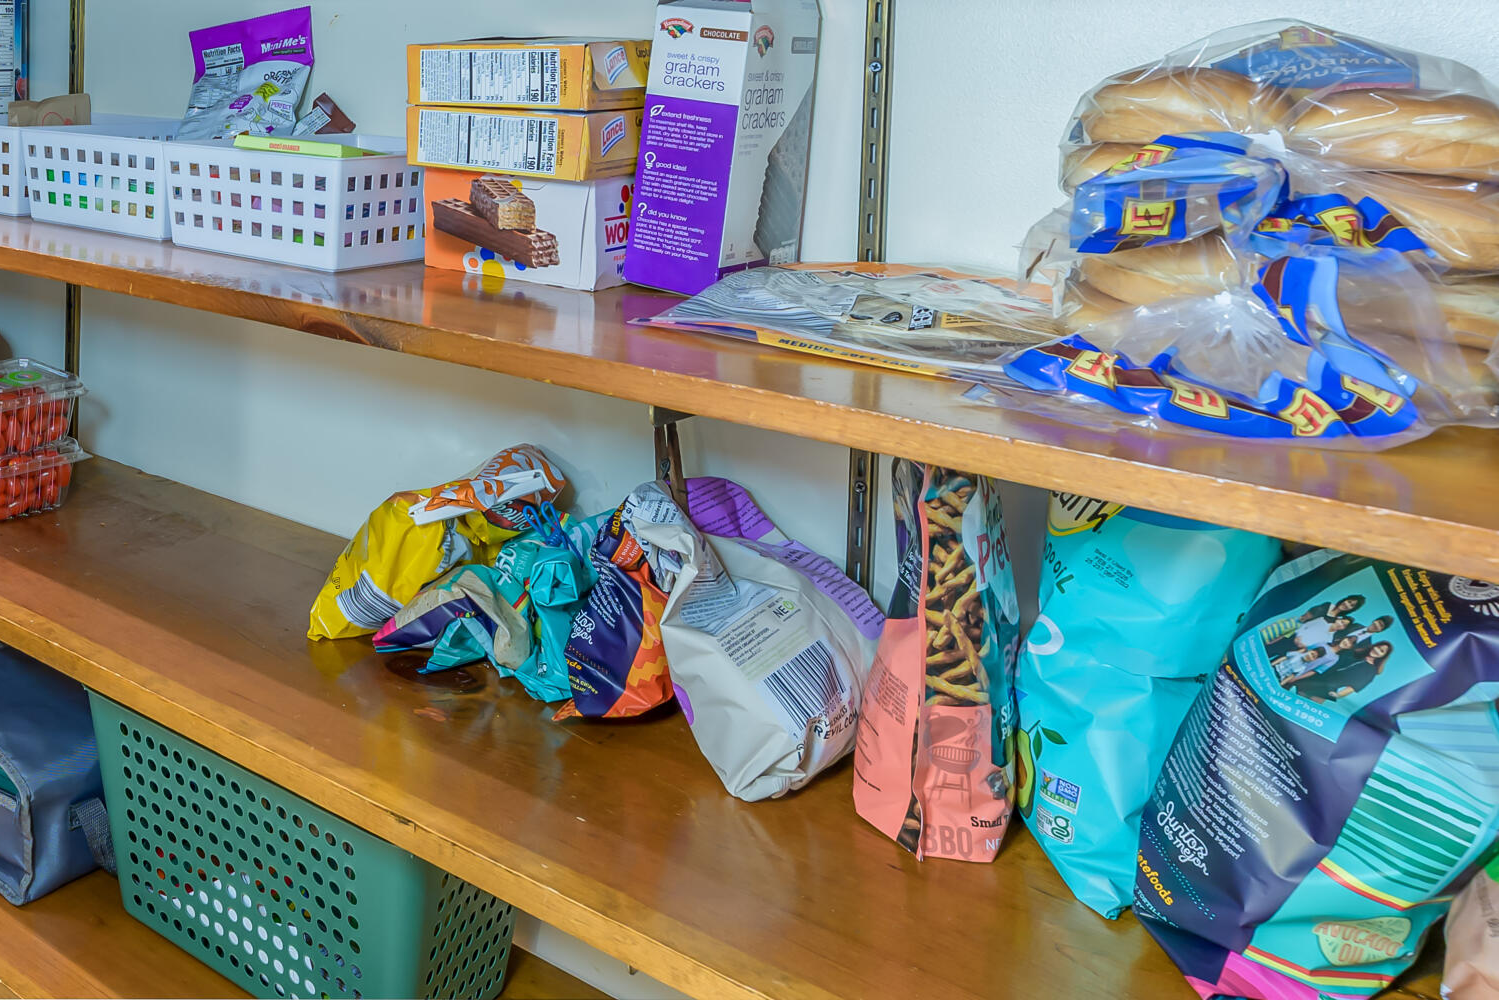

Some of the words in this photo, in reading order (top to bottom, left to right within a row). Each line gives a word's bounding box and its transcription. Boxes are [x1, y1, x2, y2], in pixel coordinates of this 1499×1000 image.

[703, 31, 740, 39] CHOCOLATE
[203, 47, 226, 58] Nutrition
[227, 45, 241, 54] Facts
[697, 56, 719, 64] crispy
[605, 49, 625, 74] Lance
[666, 61, 719, 77] graham
[664, 75, 724, 91] crackers
[531, 88, 539, 102] 190
[745, 83, 783, 111] graham
[661, 111, 681, 119] extend
[683, 113, 711, 123] freshness
[742, 107, 785, 130] crackers
[602, 121, 623, 146] Lance
[527, 156, 536, 170] 190
[546, 152, 554, 172] Facts
[670, 213, 687, 221] know
[778, 339, 835, 353] MEDIUM
[1295, 699, 1330, 719] Photo
[1295, 709, 1324, 727] 1990
[1222, 720, 1260, 748] Campos
[1232, 715, 1255, 735] from
[1230, 736, 1245, 749] my
[1213, 745, 1238, 764] could
[1238, 763, 1257, 778] still
[1256, 777, 1283, 797] enjoy
[1255, 764, 1271, 778] the
[1058, 785, 1077, 797] GMO
[1059, 780, 1078, 792] NON
[1244, 779, 1280, 807] without
[1228, 794, 1268, 826] delicious
[1157, 800, 1209, 859] Juntos
[1227, 825, 1241, 838] the
[1243, 817, 1270, 839] using
[1173, 837, 1210, 876] mejor
[1313, 922, 1404, 957] AVOCADO
[1338, 943, 1364, 964] OIL
